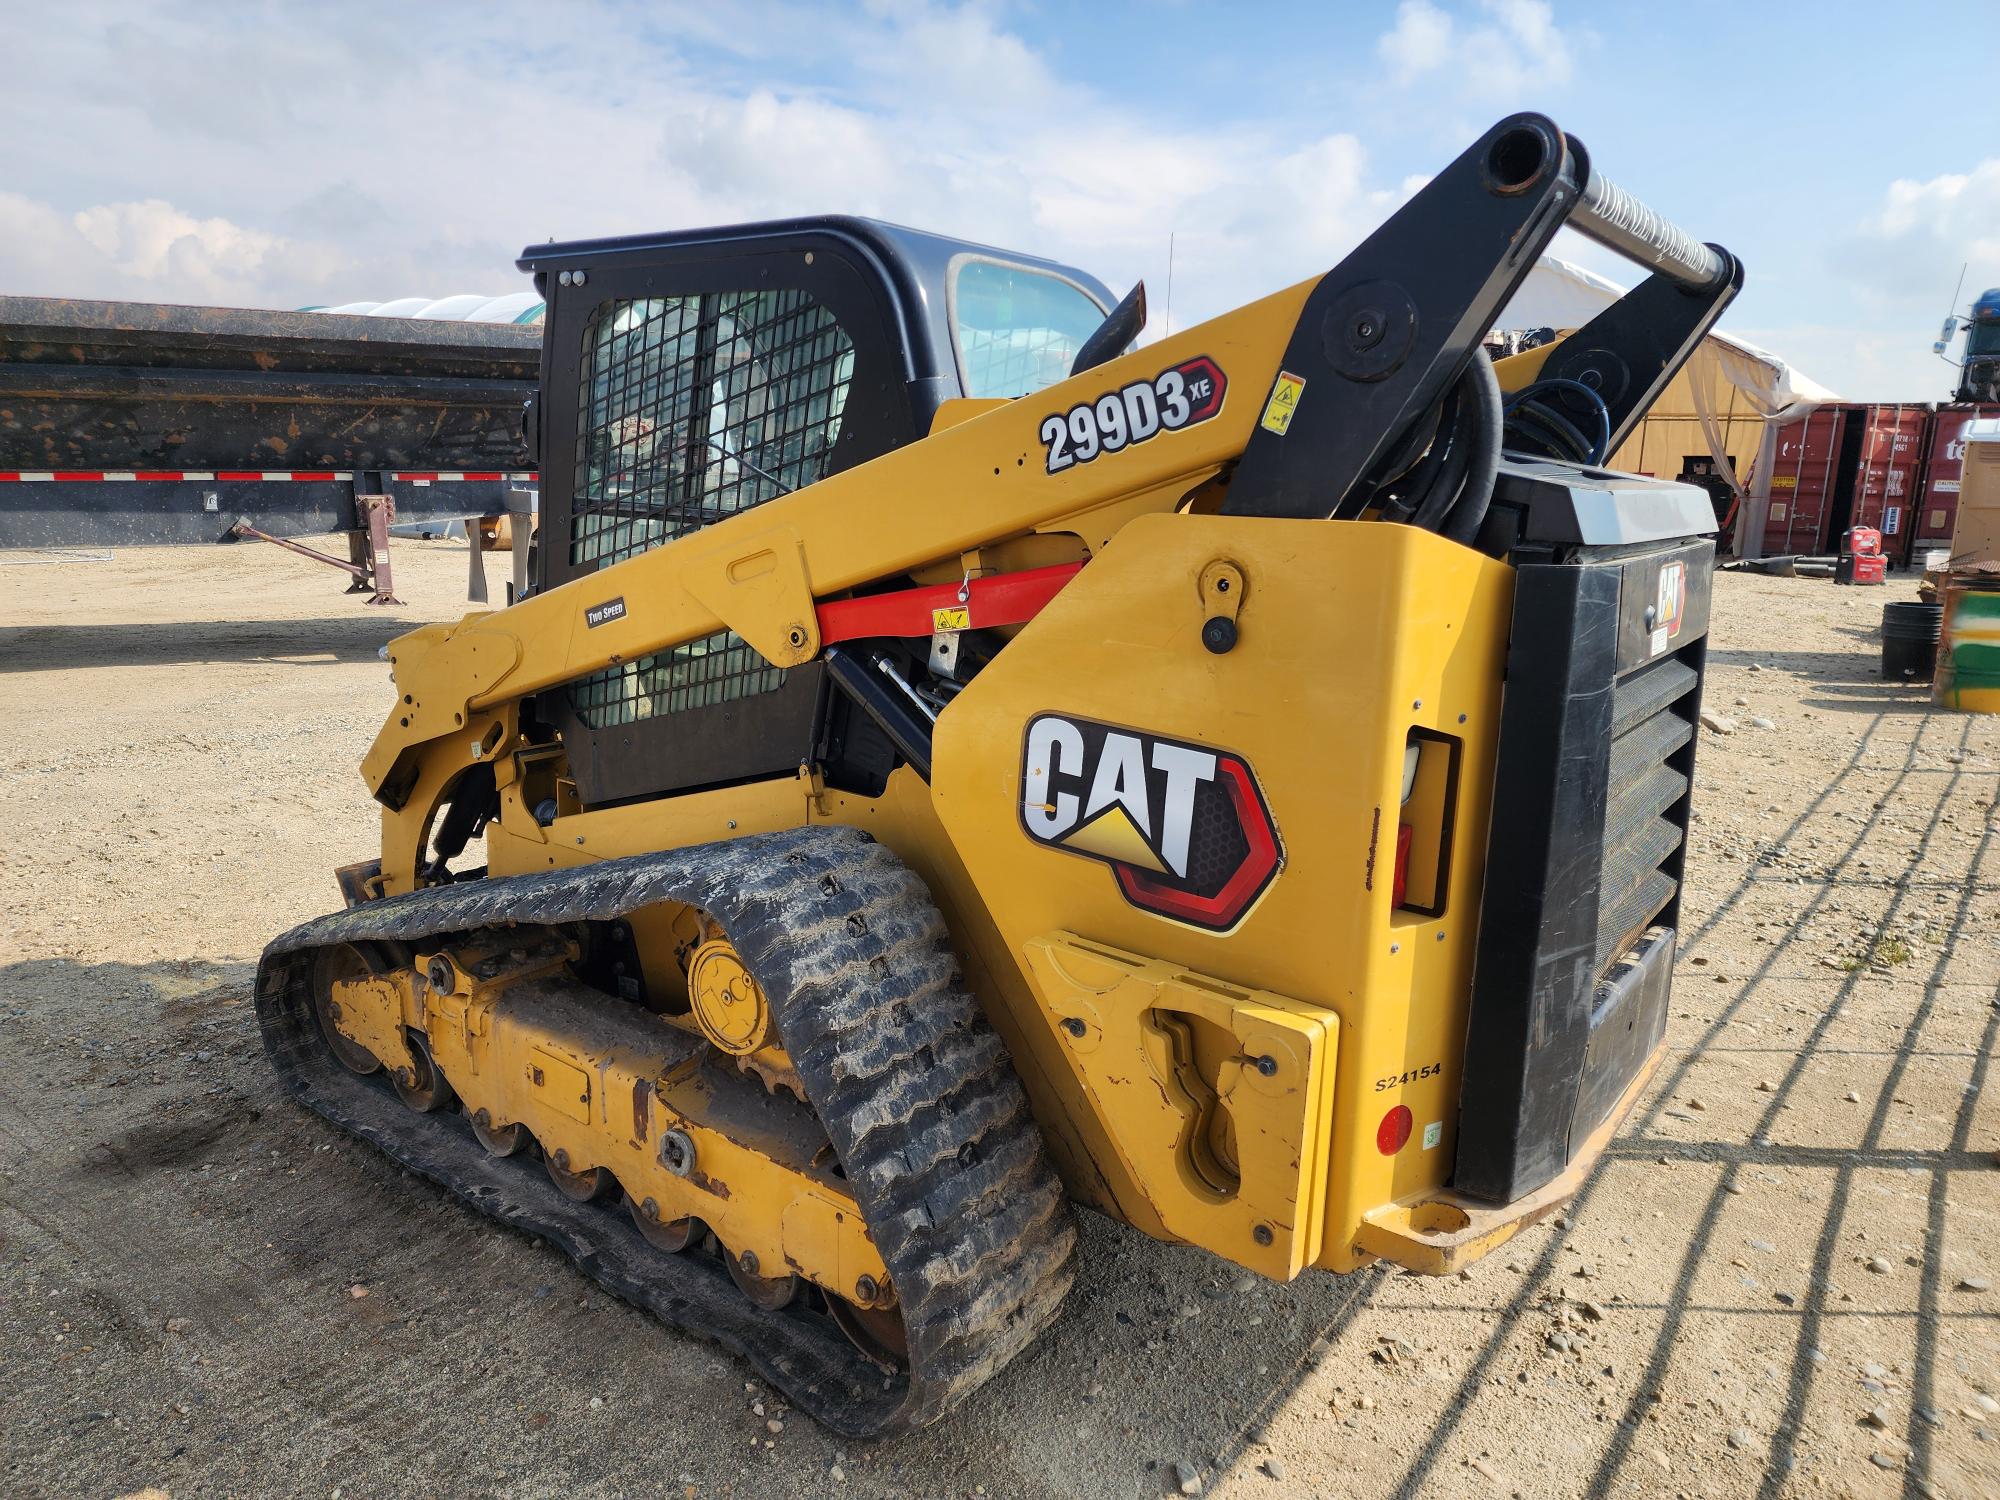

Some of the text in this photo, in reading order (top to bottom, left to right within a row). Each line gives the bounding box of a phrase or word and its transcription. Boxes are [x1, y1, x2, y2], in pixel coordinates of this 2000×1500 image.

[1042, 371, 1211, 471] 299D3 XE
[1657, 565, 1681, 624] CAT
[1025, 717, 1217, 879] CAT
[1375, 1063, 1441, 1092] S24154
